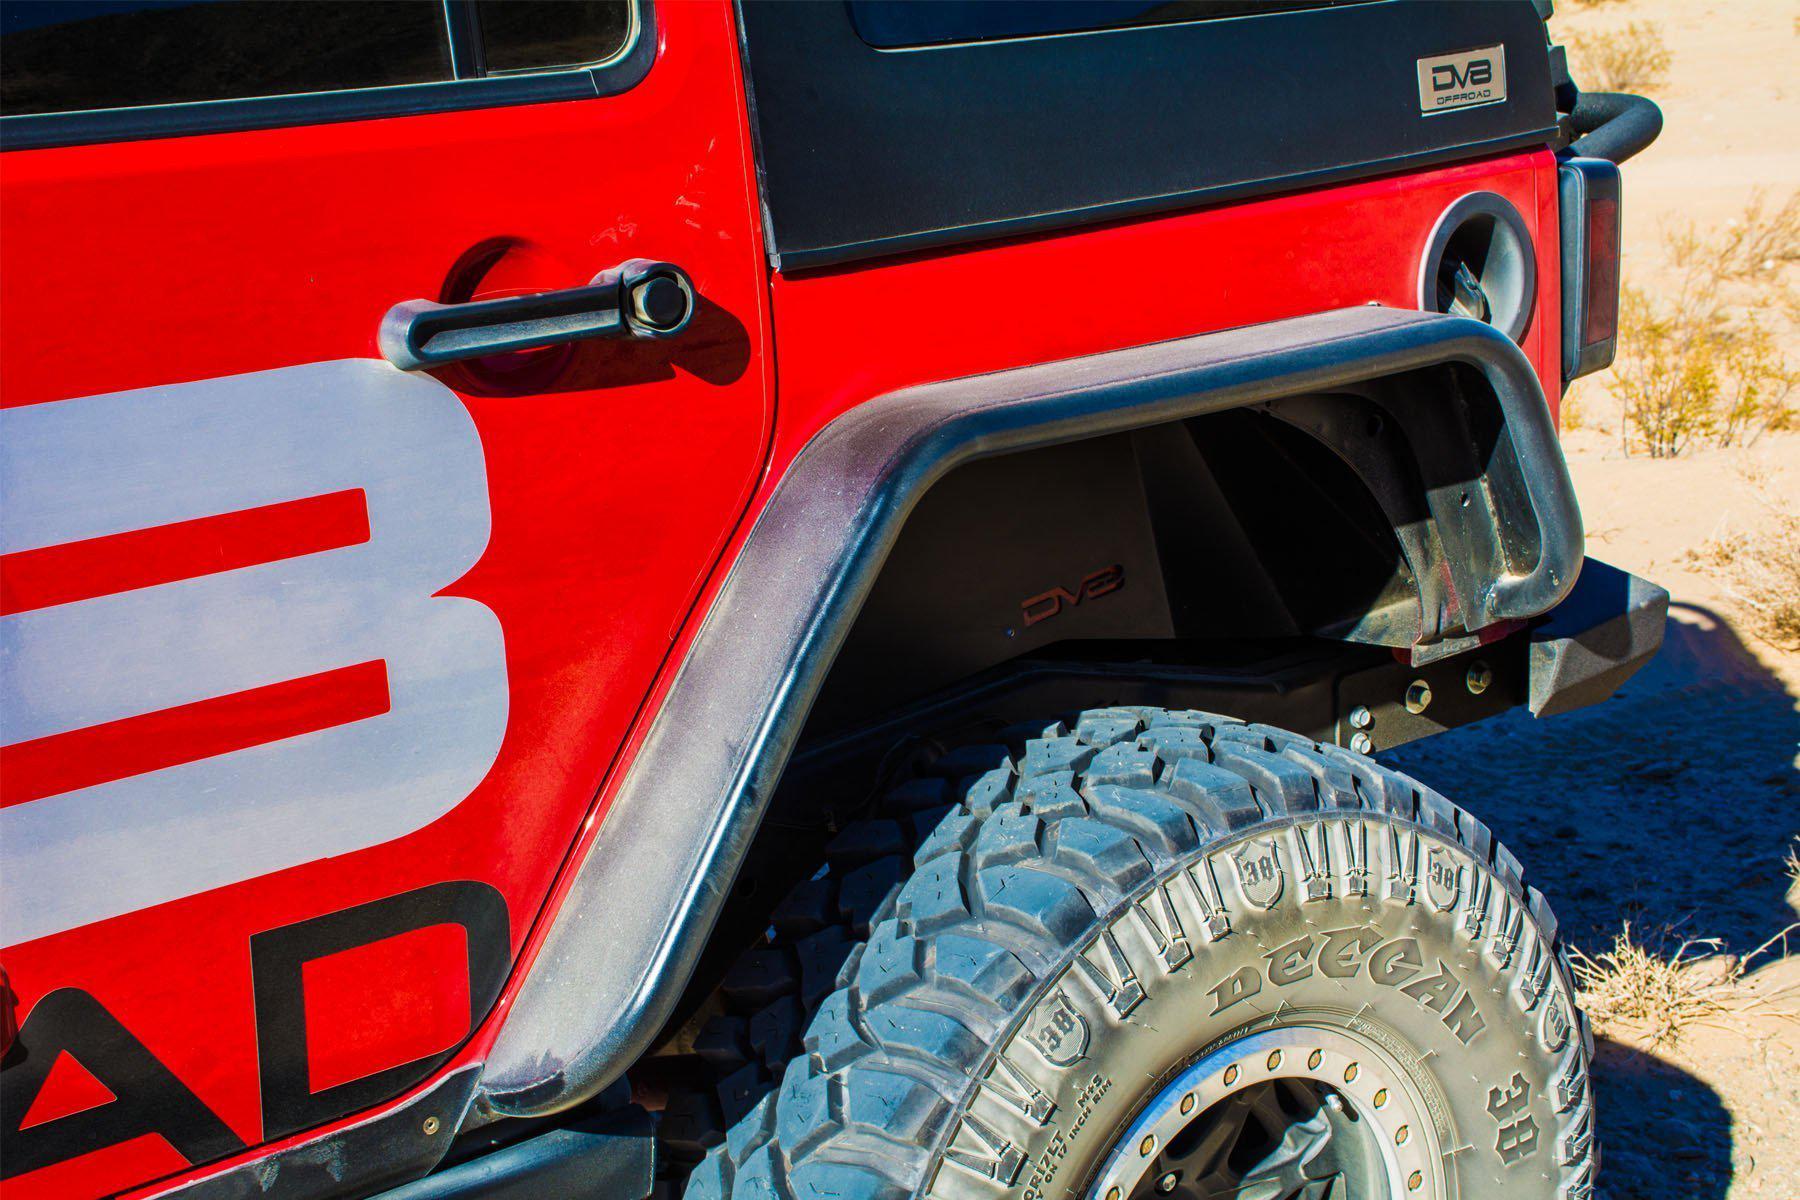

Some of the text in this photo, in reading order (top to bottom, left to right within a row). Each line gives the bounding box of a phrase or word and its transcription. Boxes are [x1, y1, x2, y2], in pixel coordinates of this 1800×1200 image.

[1432, 59, 1492, 92] DV8
[1436, 89, 1491, 105] OFFROAD
[1021, 563, 1126, 627] DV8
[1242, 855, 1275, 886] 38
[1432, 861, 1454, 891] 38
[1204, 925, 1487, 1046] DEEGAN
[1038, 1007, 1076, 1053] 38
[1486, 1072, 1540, 1168] 38
